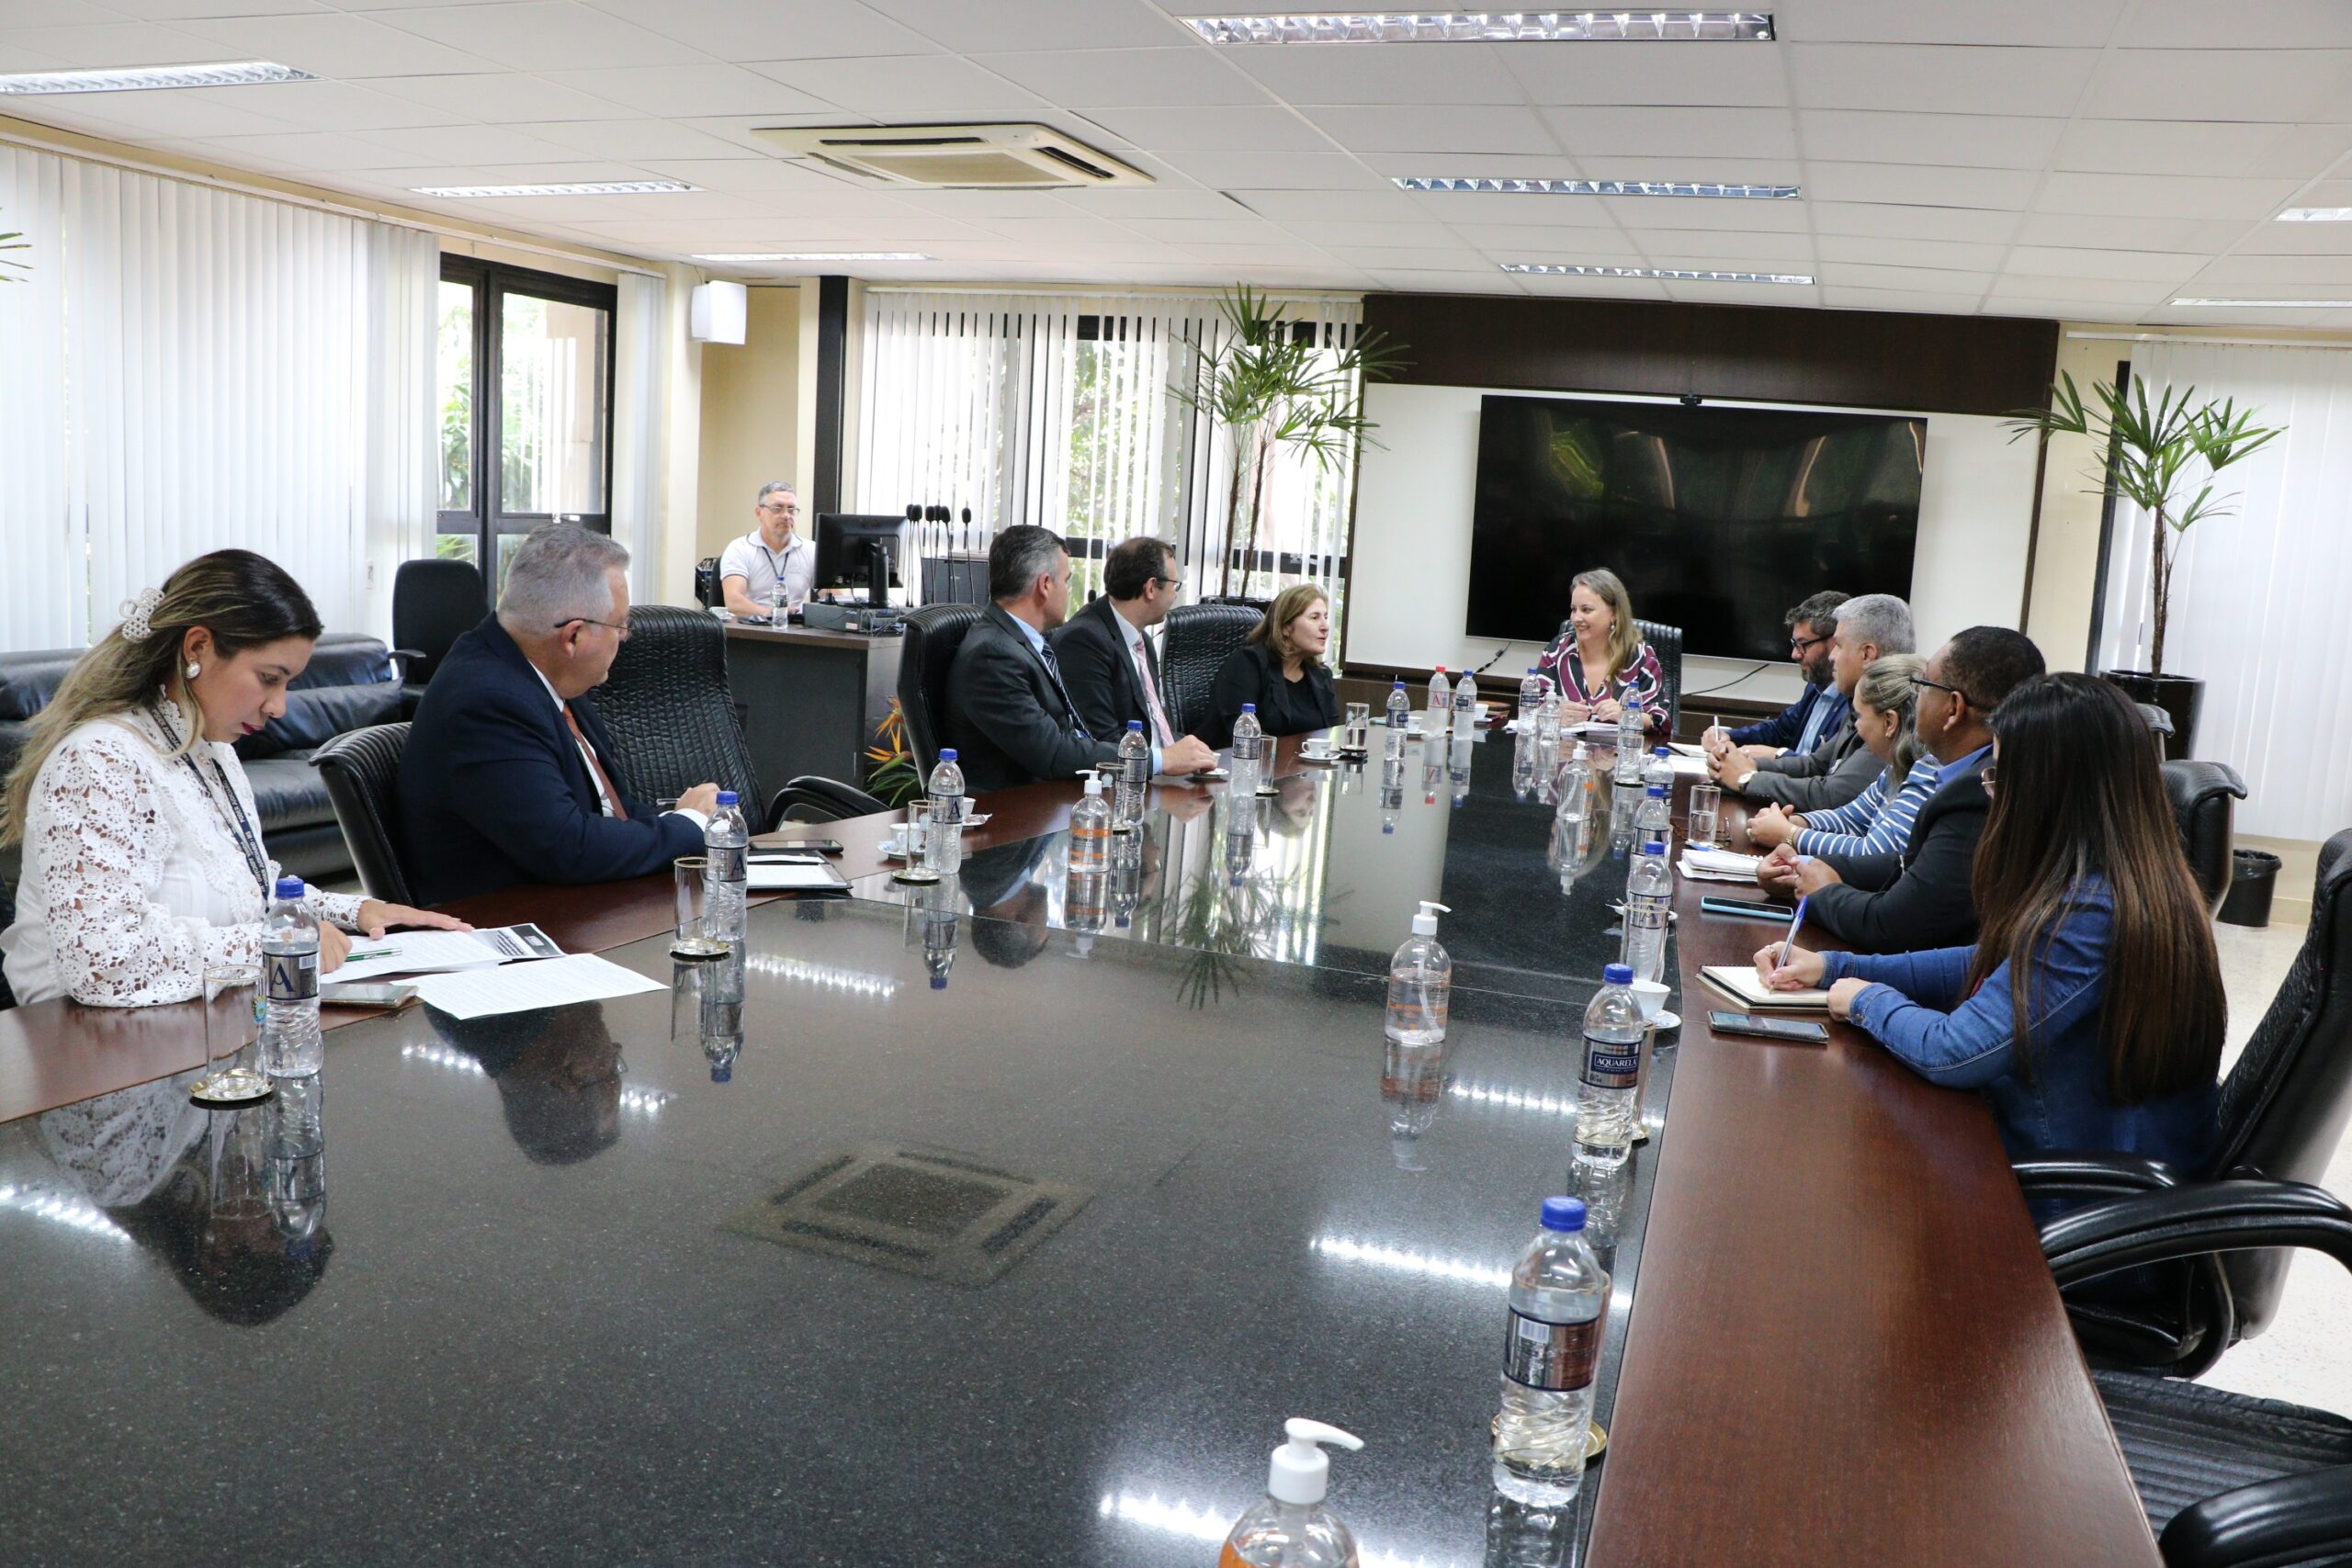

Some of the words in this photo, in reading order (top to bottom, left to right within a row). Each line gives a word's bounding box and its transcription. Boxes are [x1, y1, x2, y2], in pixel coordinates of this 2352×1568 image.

[233, 805, 245, 823] PODER
[947, 800, 961, 819] A
[244, 829, 253, 840] MS
[730, 852, 746, 876] A
[260, 868, 268, 886] PODER
[270, 963, 294, 993] A
